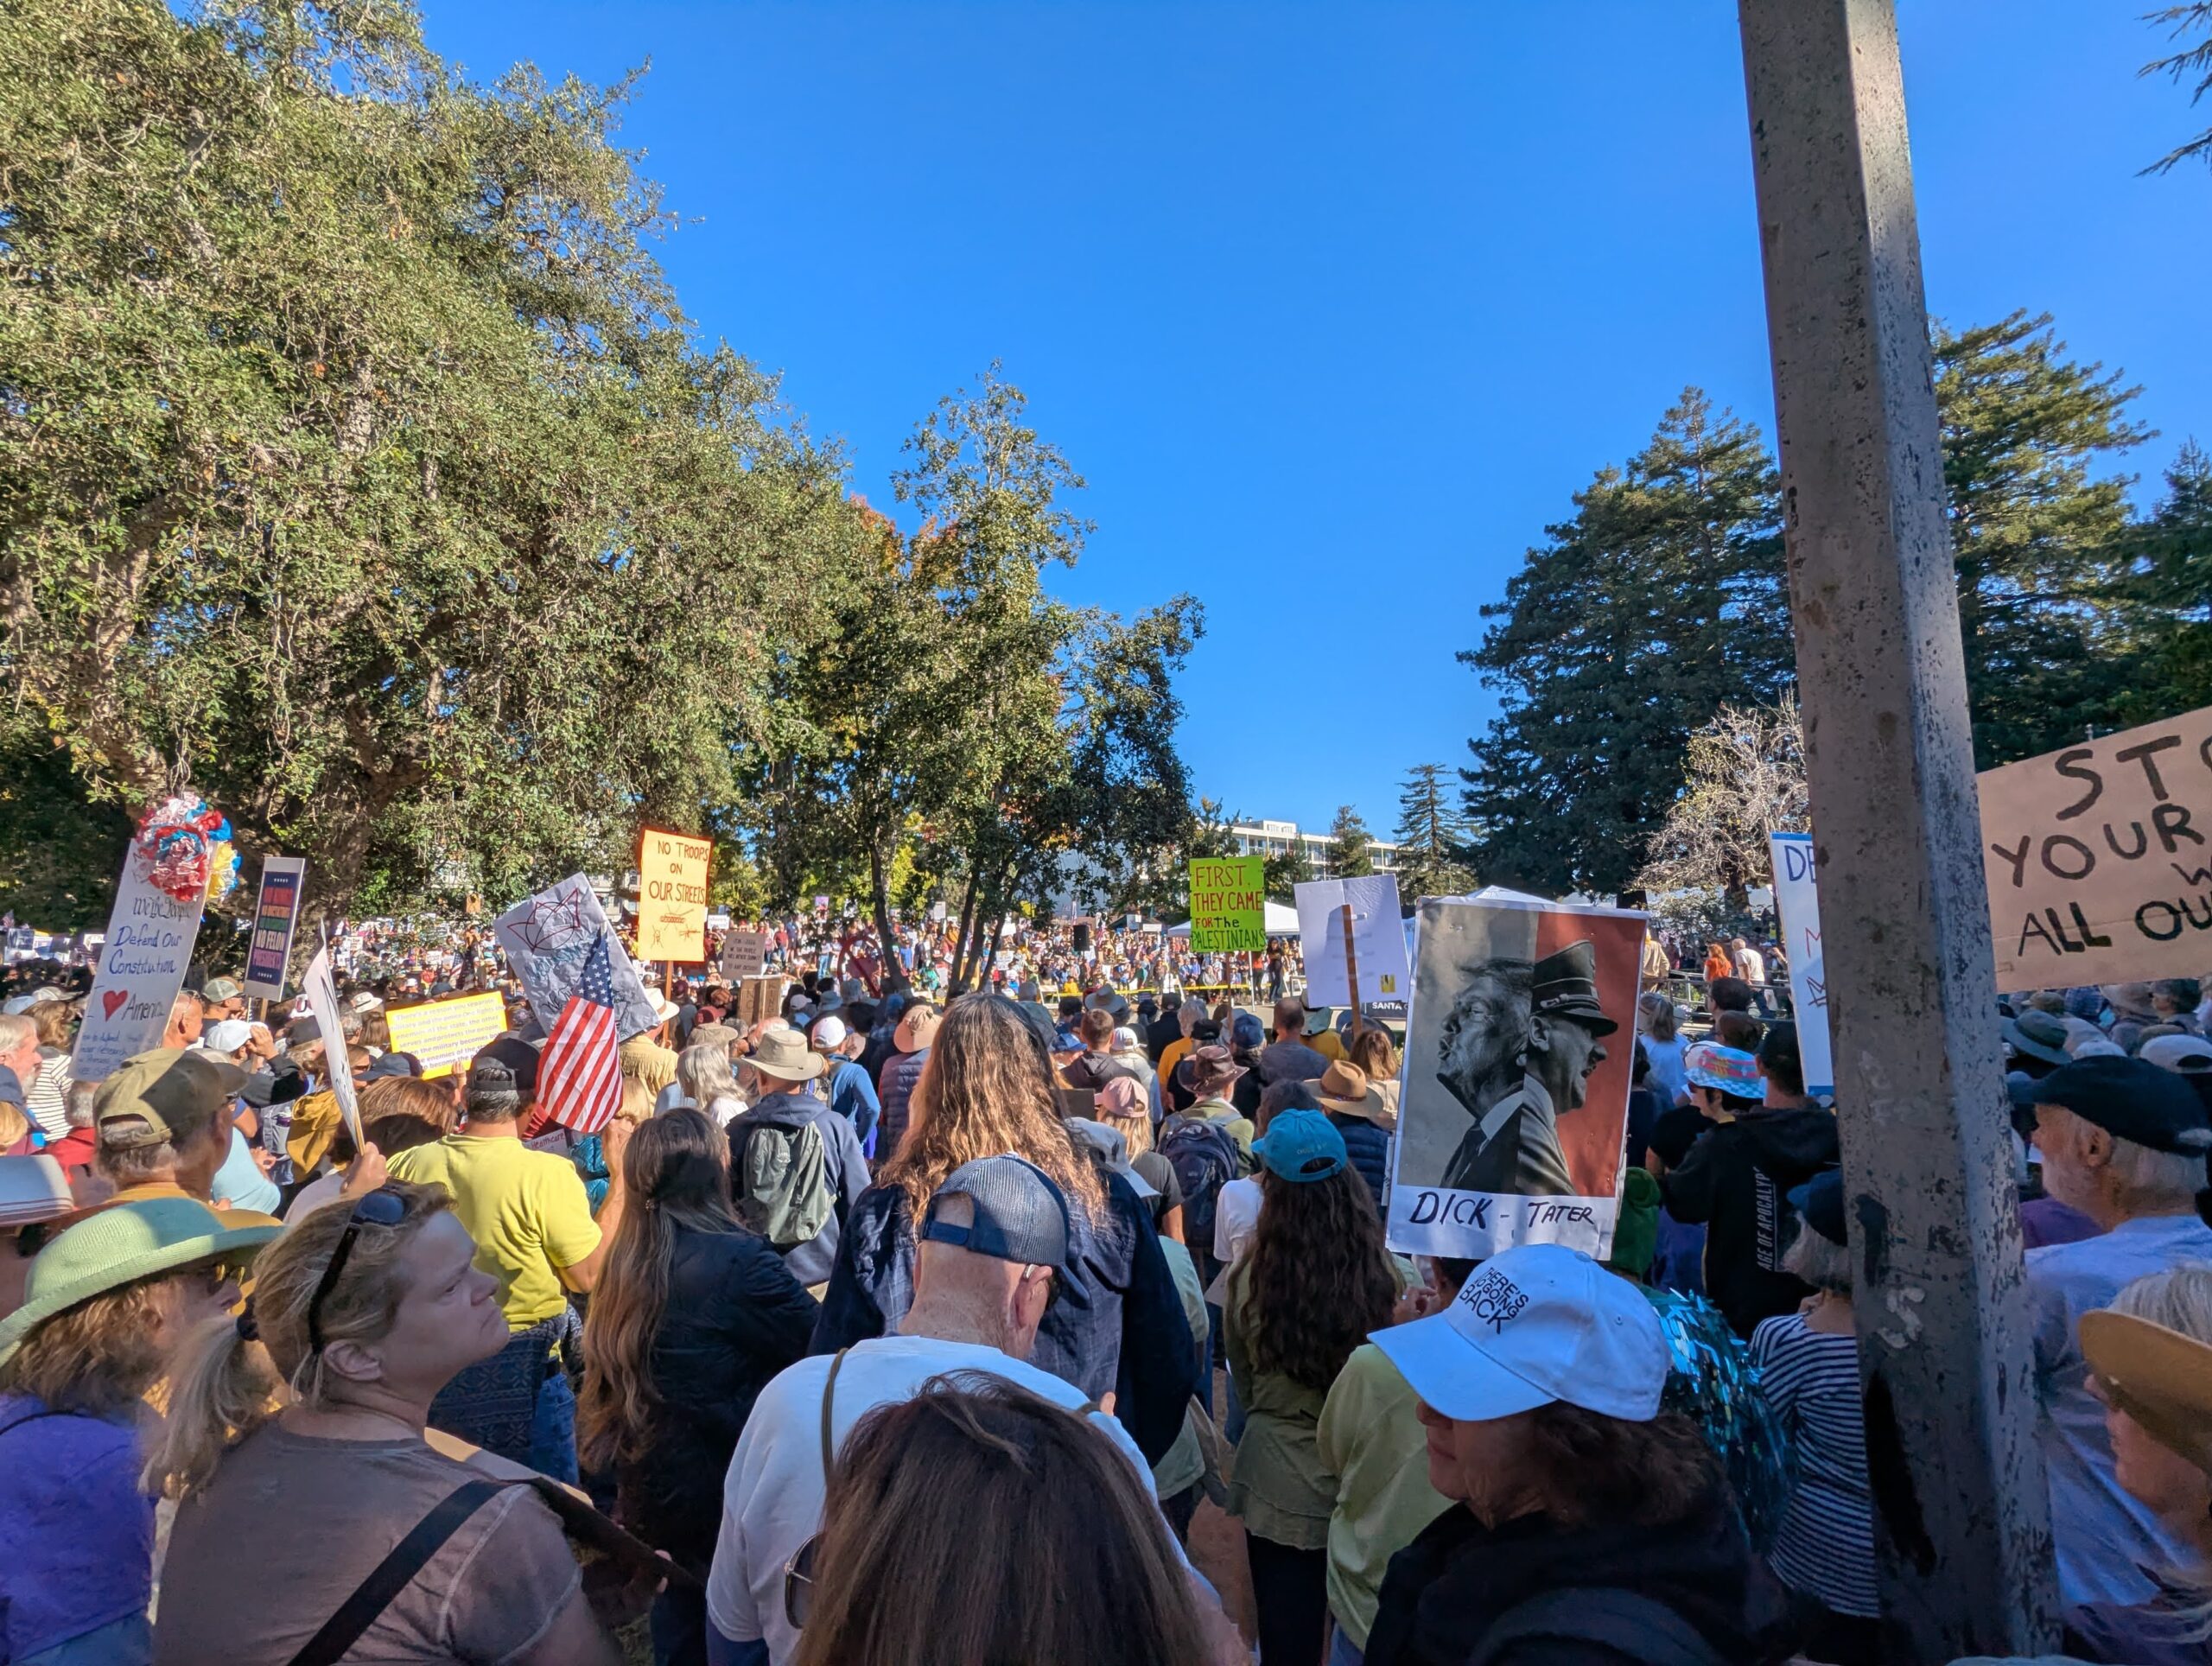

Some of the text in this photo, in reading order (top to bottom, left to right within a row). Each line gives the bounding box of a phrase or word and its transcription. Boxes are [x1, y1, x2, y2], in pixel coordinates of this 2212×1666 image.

[2055, 735, 2212, 820] ST
[658, 840, 709, 862] NO TROOPS
[1991, 803, 2205, 888] YOUR
[670, 862, 683, 875] ON
[649, 881, 705, 905] OUR STREETS
[1193, 891, 1264, 912] THEY CAME
[113, 923, 182, 948] Defend Our
[1195, 917, 1213, 929] FOR
[2018, 890, 2212, 956] ALL OU
[1192, 928, 1267, 950] PALESTINIANS
[109, 949, 177, 976] Constitution
[121, 994, 166, 1021] America
[1371, 1002, 1402, 1010] SANTA
[1409, 1191, 1493, 1230] DICK
[1527, 1201, 1596, 1228] TATER
[1752, 1167, 1773, 1272] AGE OF APOCALYP
[1482, 1282, 1520, 1319] GOING
[1484, 1267, 1529, 1308] THERE'S
[1459, 1283, 1513, 1335] BACK
